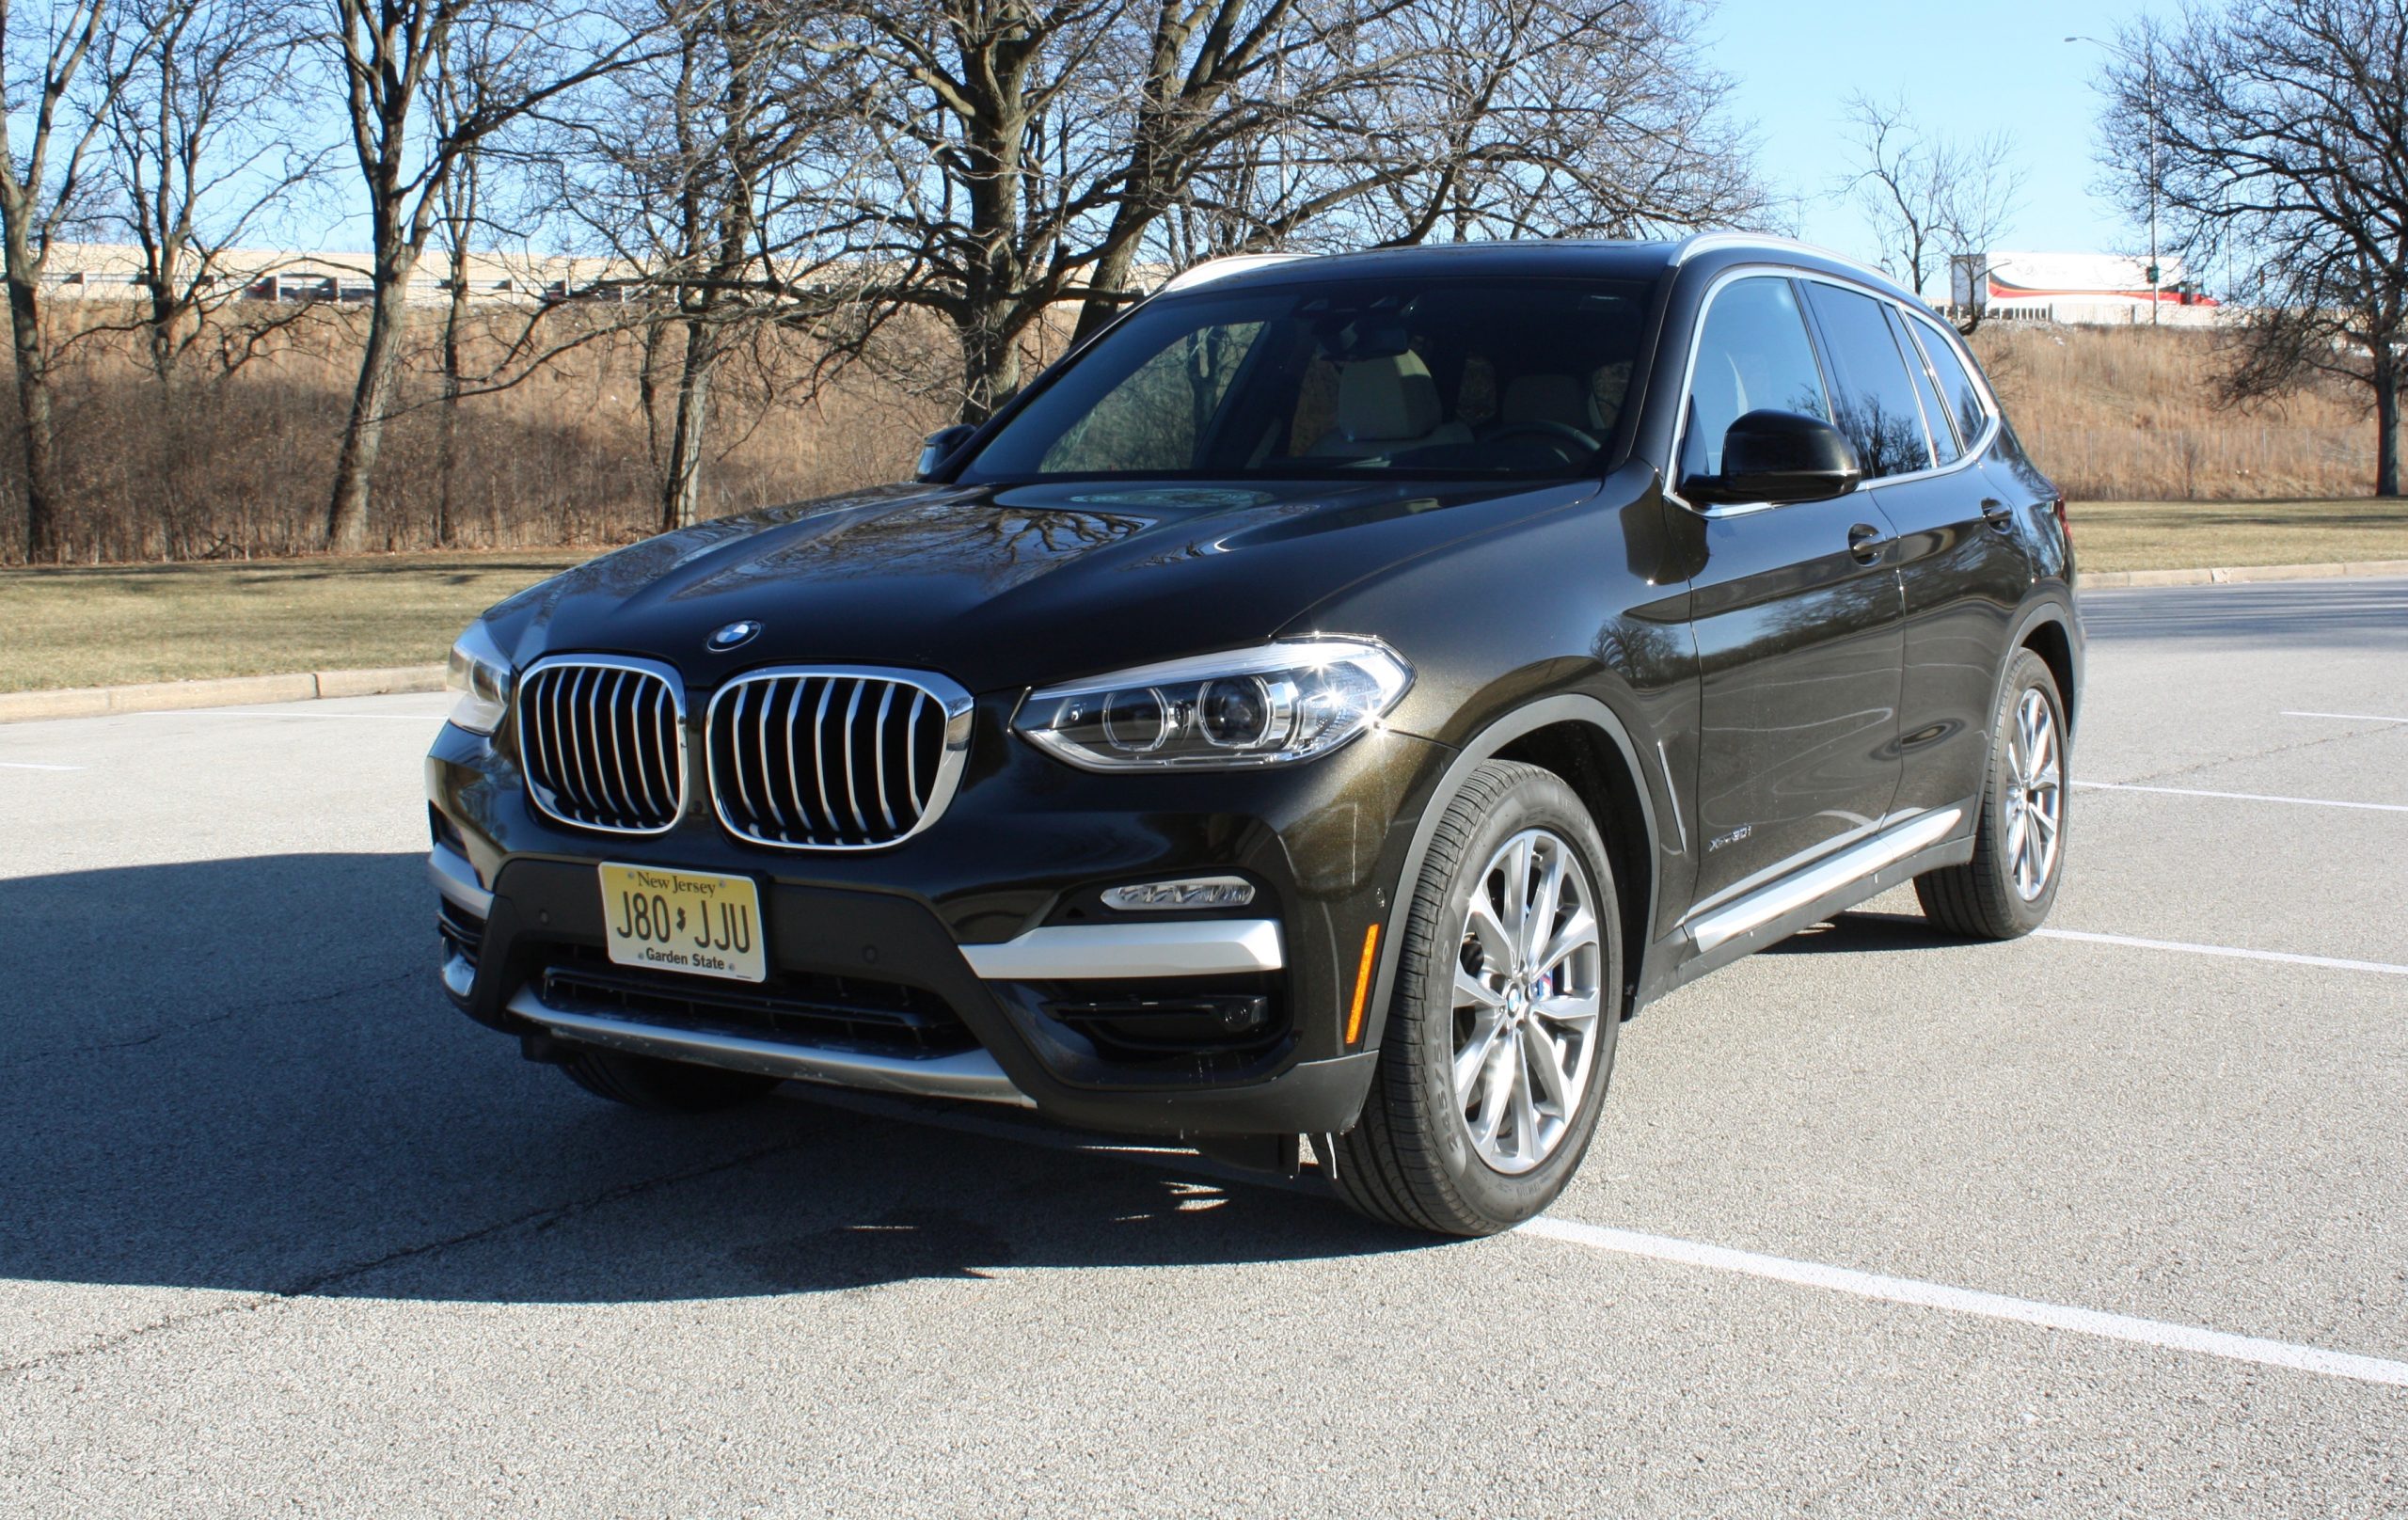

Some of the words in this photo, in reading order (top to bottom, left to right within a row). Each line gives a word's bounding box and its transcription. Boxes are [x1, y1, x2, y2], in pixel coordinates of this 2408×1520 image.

[637, 871, 670, 888] New
[673, 875, 716, 898] Jersey
[616, 891, 671, 943] J80
[694, 900, 751, 954] JJU
[646, 947, 689, 965] Garden
[692, 953, 725, 970] State
